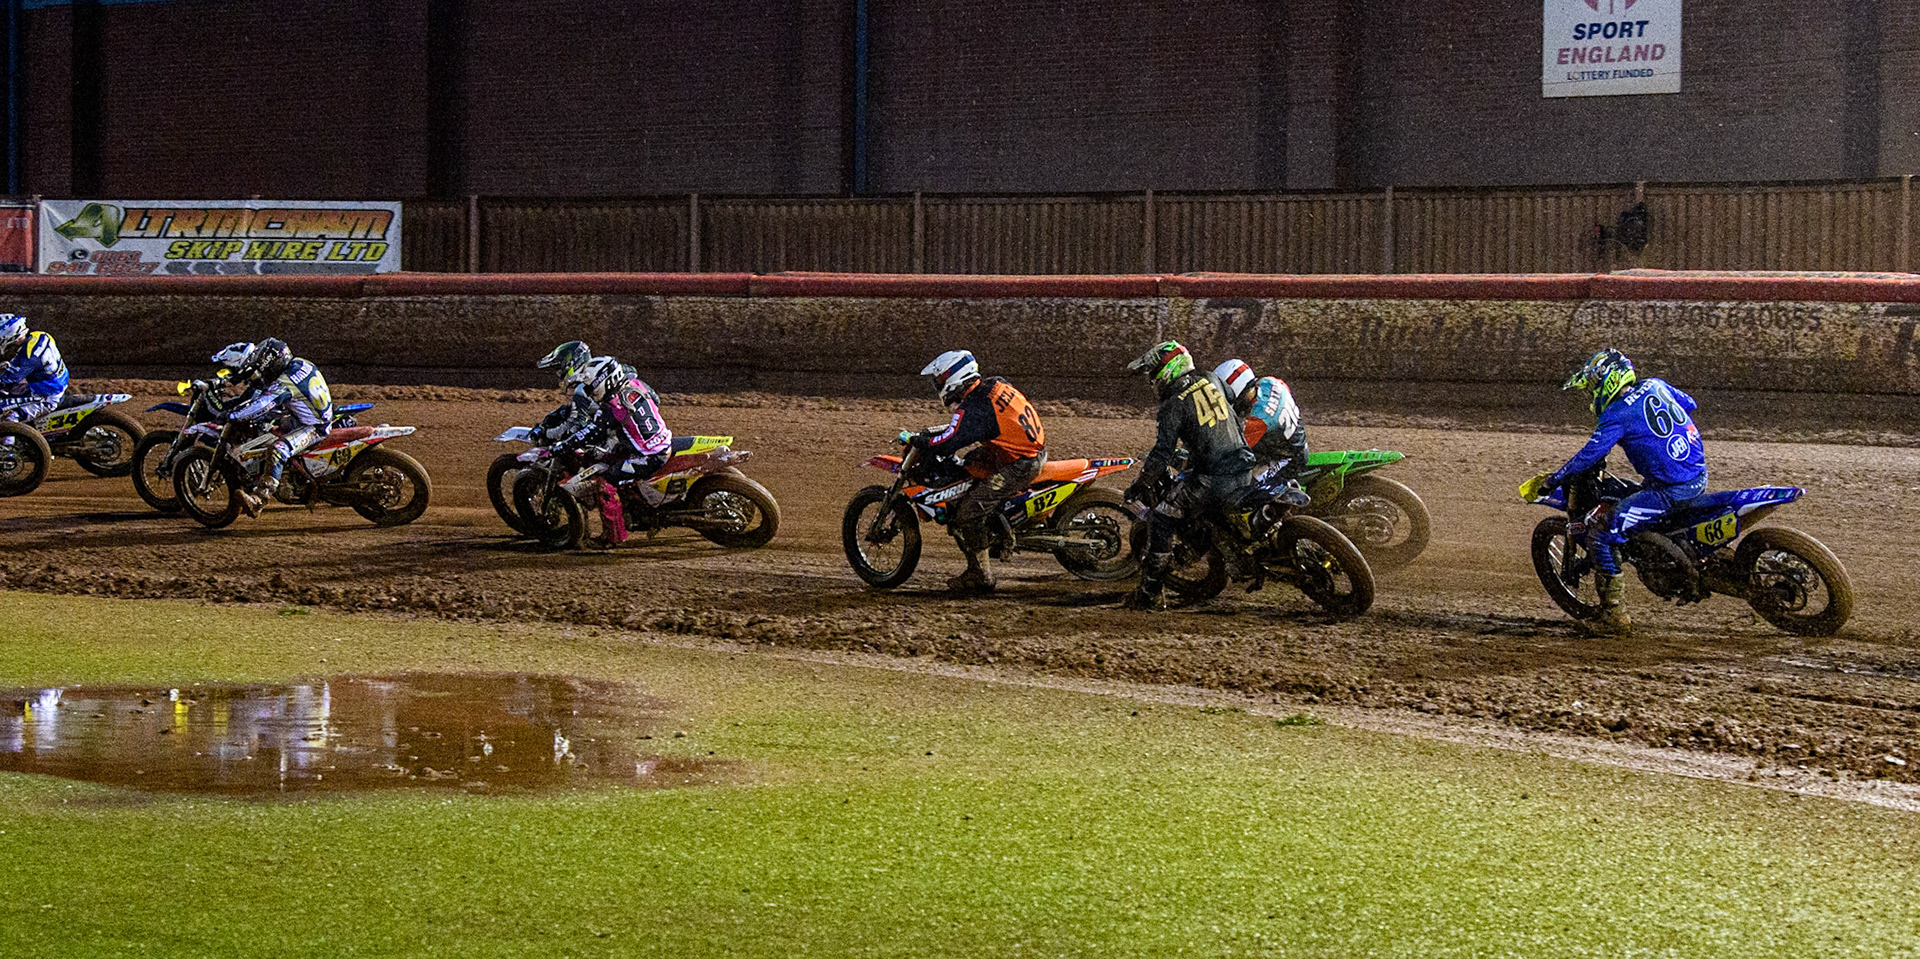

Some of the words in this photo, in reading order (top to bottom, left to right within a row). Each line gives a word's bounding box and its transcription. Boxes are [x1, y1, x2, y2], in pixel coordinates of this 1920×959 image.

[1573, 20, 1649, 40] SPORT
[1557, 43, 1666, 65] ENGLAND
[1567, 70, 1610, 81] LOTTERY
[1613, 68, 1654, 80] FUNDED
[90, 250, 142, 262] 0161
[164, 240, 244, 260] SKIP
[243, 241, 324, 261] HIRE
[325, 241, 390, 261] LTD
[1192, 383, 1229, 428] 45
[1643, 385, 1688, 439] 68
[924, 480, 974, 505] SCHRUF
[1033, 490, 1058, 513] 82
[1704, 520, 1725, 543] 68
